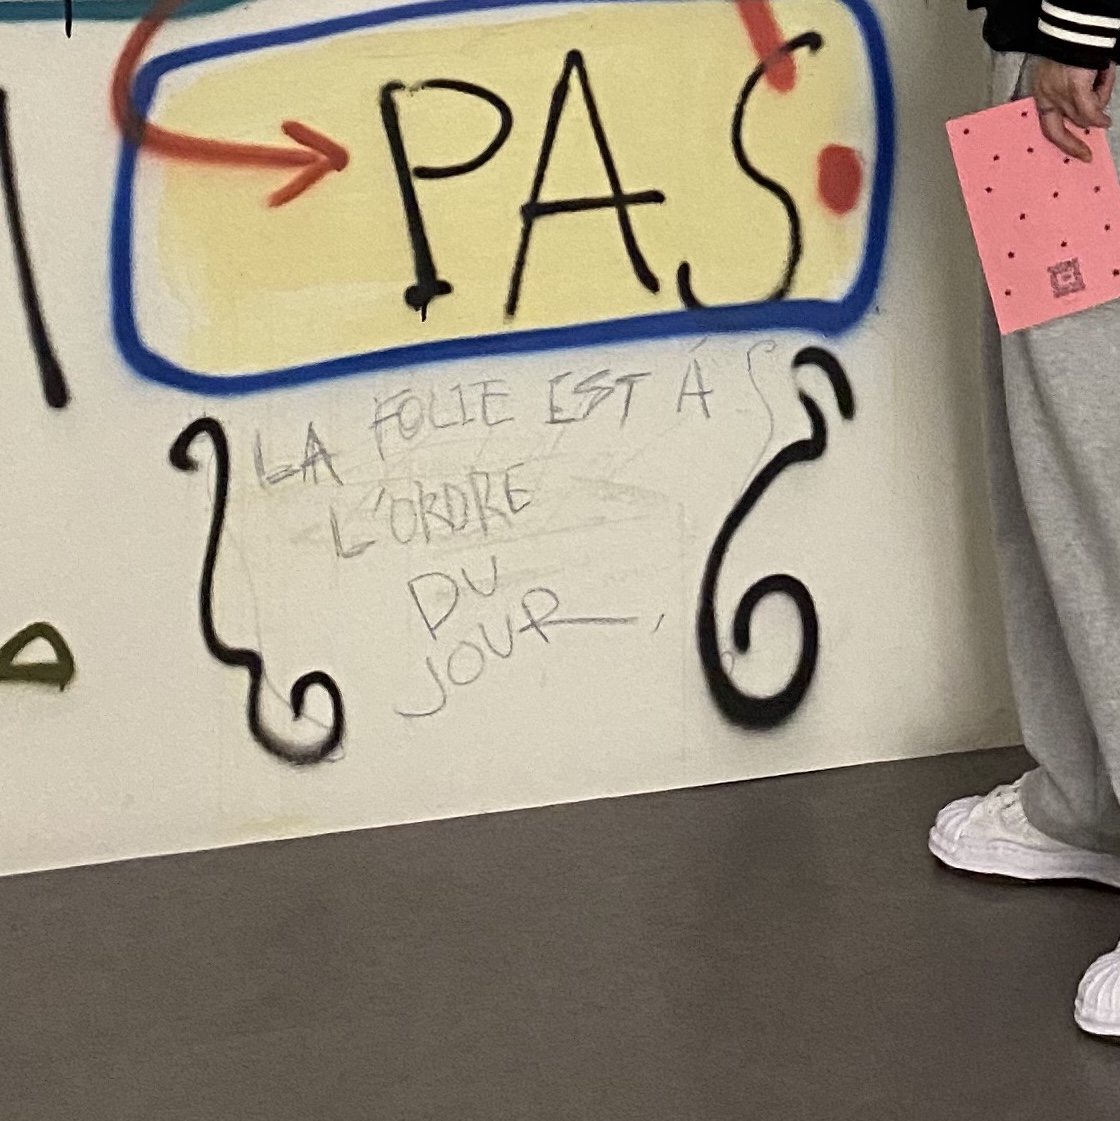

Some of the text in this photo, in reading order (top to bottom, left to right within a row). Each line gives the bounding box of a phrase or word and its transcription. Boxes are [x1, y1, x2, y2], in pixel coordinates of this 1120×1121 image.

[379, 30, 825, 325] PAS
[253, 420, 344, 489] LA
[373, 376, 512, 461] FOLIE
[545, 369, 654, 429] EST
[327, 461, 534, 560] L'ORDRE
[408, 555, 500, 639] DU
